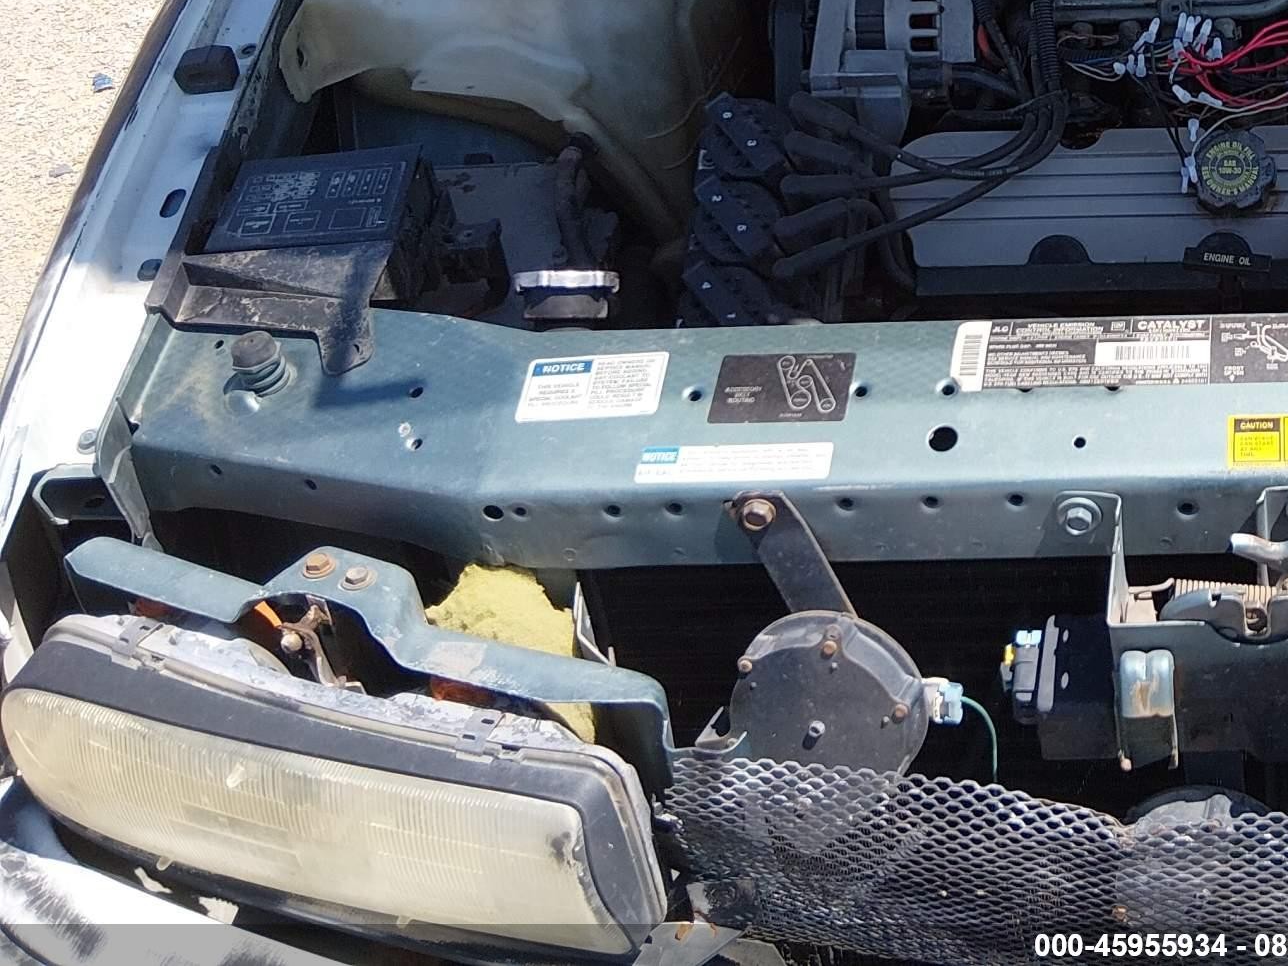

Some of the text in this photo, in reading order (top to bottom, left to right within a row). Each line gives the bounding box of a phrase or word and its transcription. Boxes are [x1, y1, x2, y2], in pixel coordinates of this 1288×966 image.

[746, 139, 758, 147] 3
[1205, 141, 1231, 159] ENGINE
[1201, 166, 1211, 180] SEE
[1218, 167, 1242, 175] 10W-30
[1203, 252, 1251, 266] ENGINE OIL
[1137, 319, 1206, 331] CATALYST
[542, 362, 586, 374] NOTICE
[1240, 421, 1274, 431] CAUTION
[641, 451, 679, 464] NOTICE
